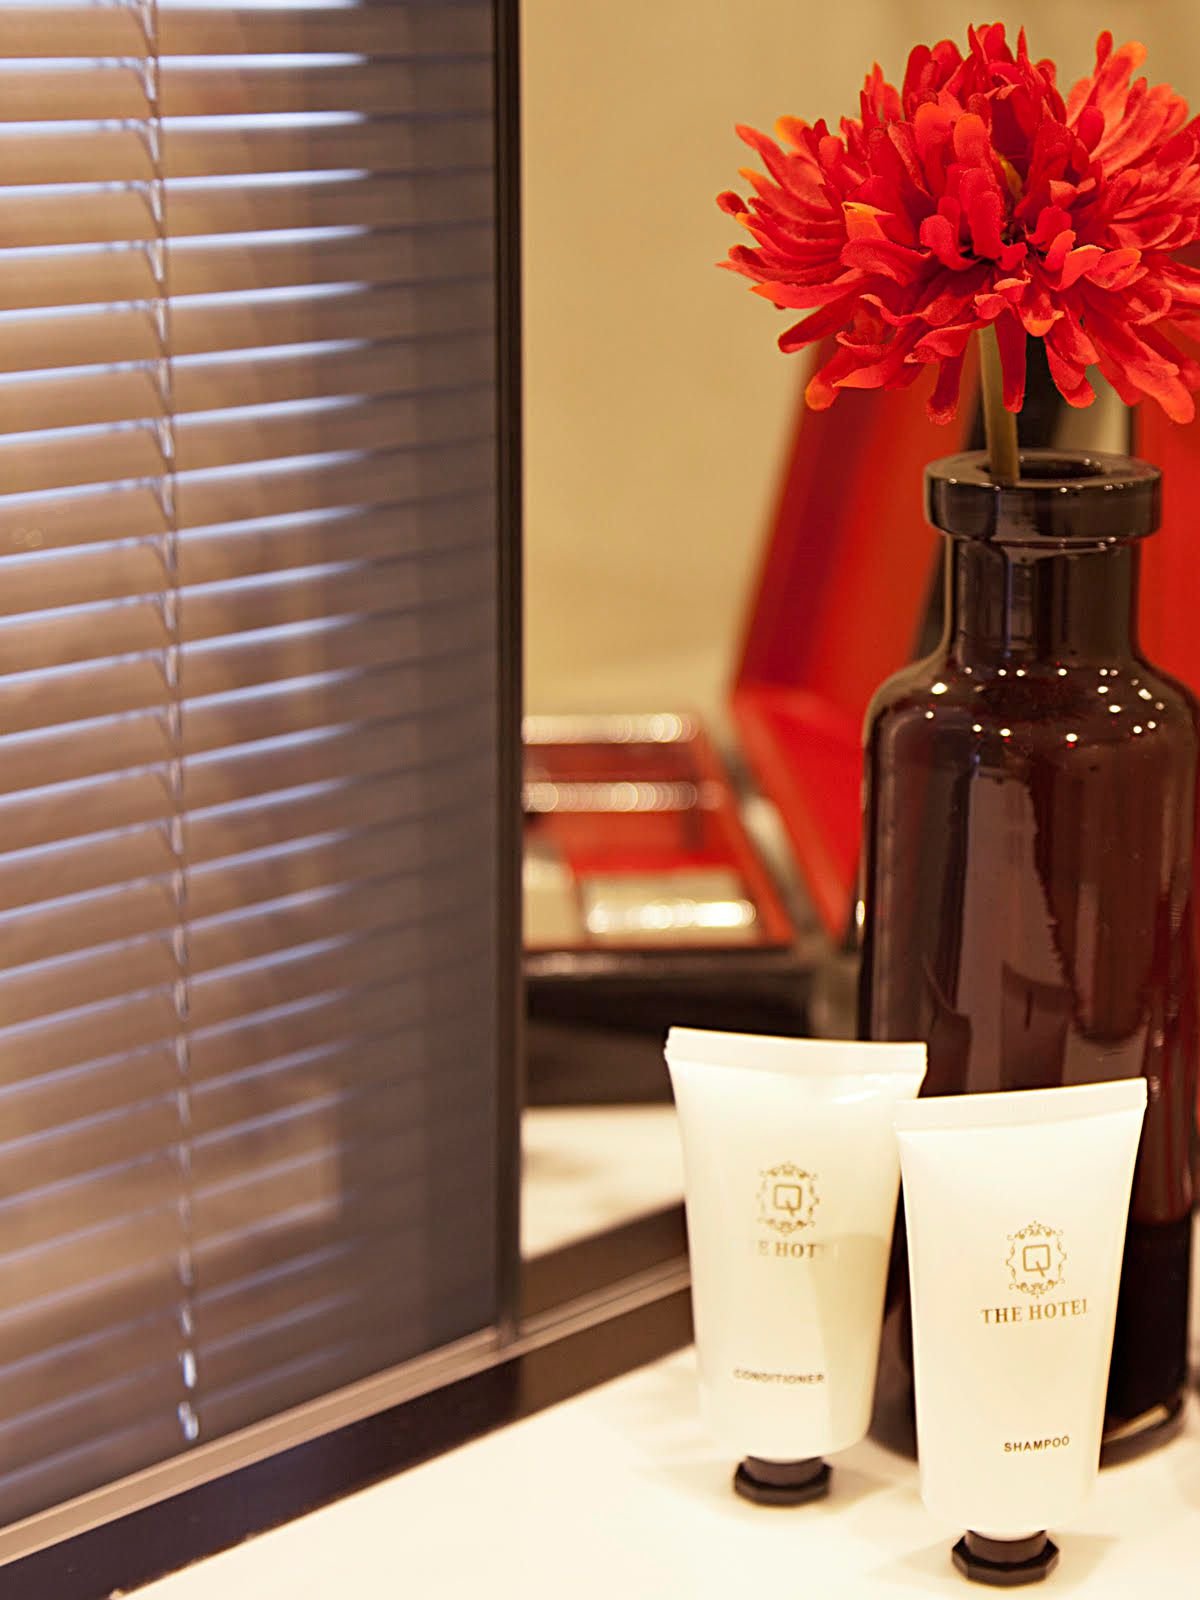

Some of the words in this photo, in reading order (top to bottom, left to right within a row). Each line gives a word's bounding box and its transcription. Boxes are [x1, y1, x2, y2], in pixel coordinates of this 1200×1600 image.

[774, 1184, 802, 1216] Q
[1022, 1244, 1051, 1278] Q
[981, 1306, 1023, 1324] THE
[1003, 1435, 1070, 1452] SHAMPOO
